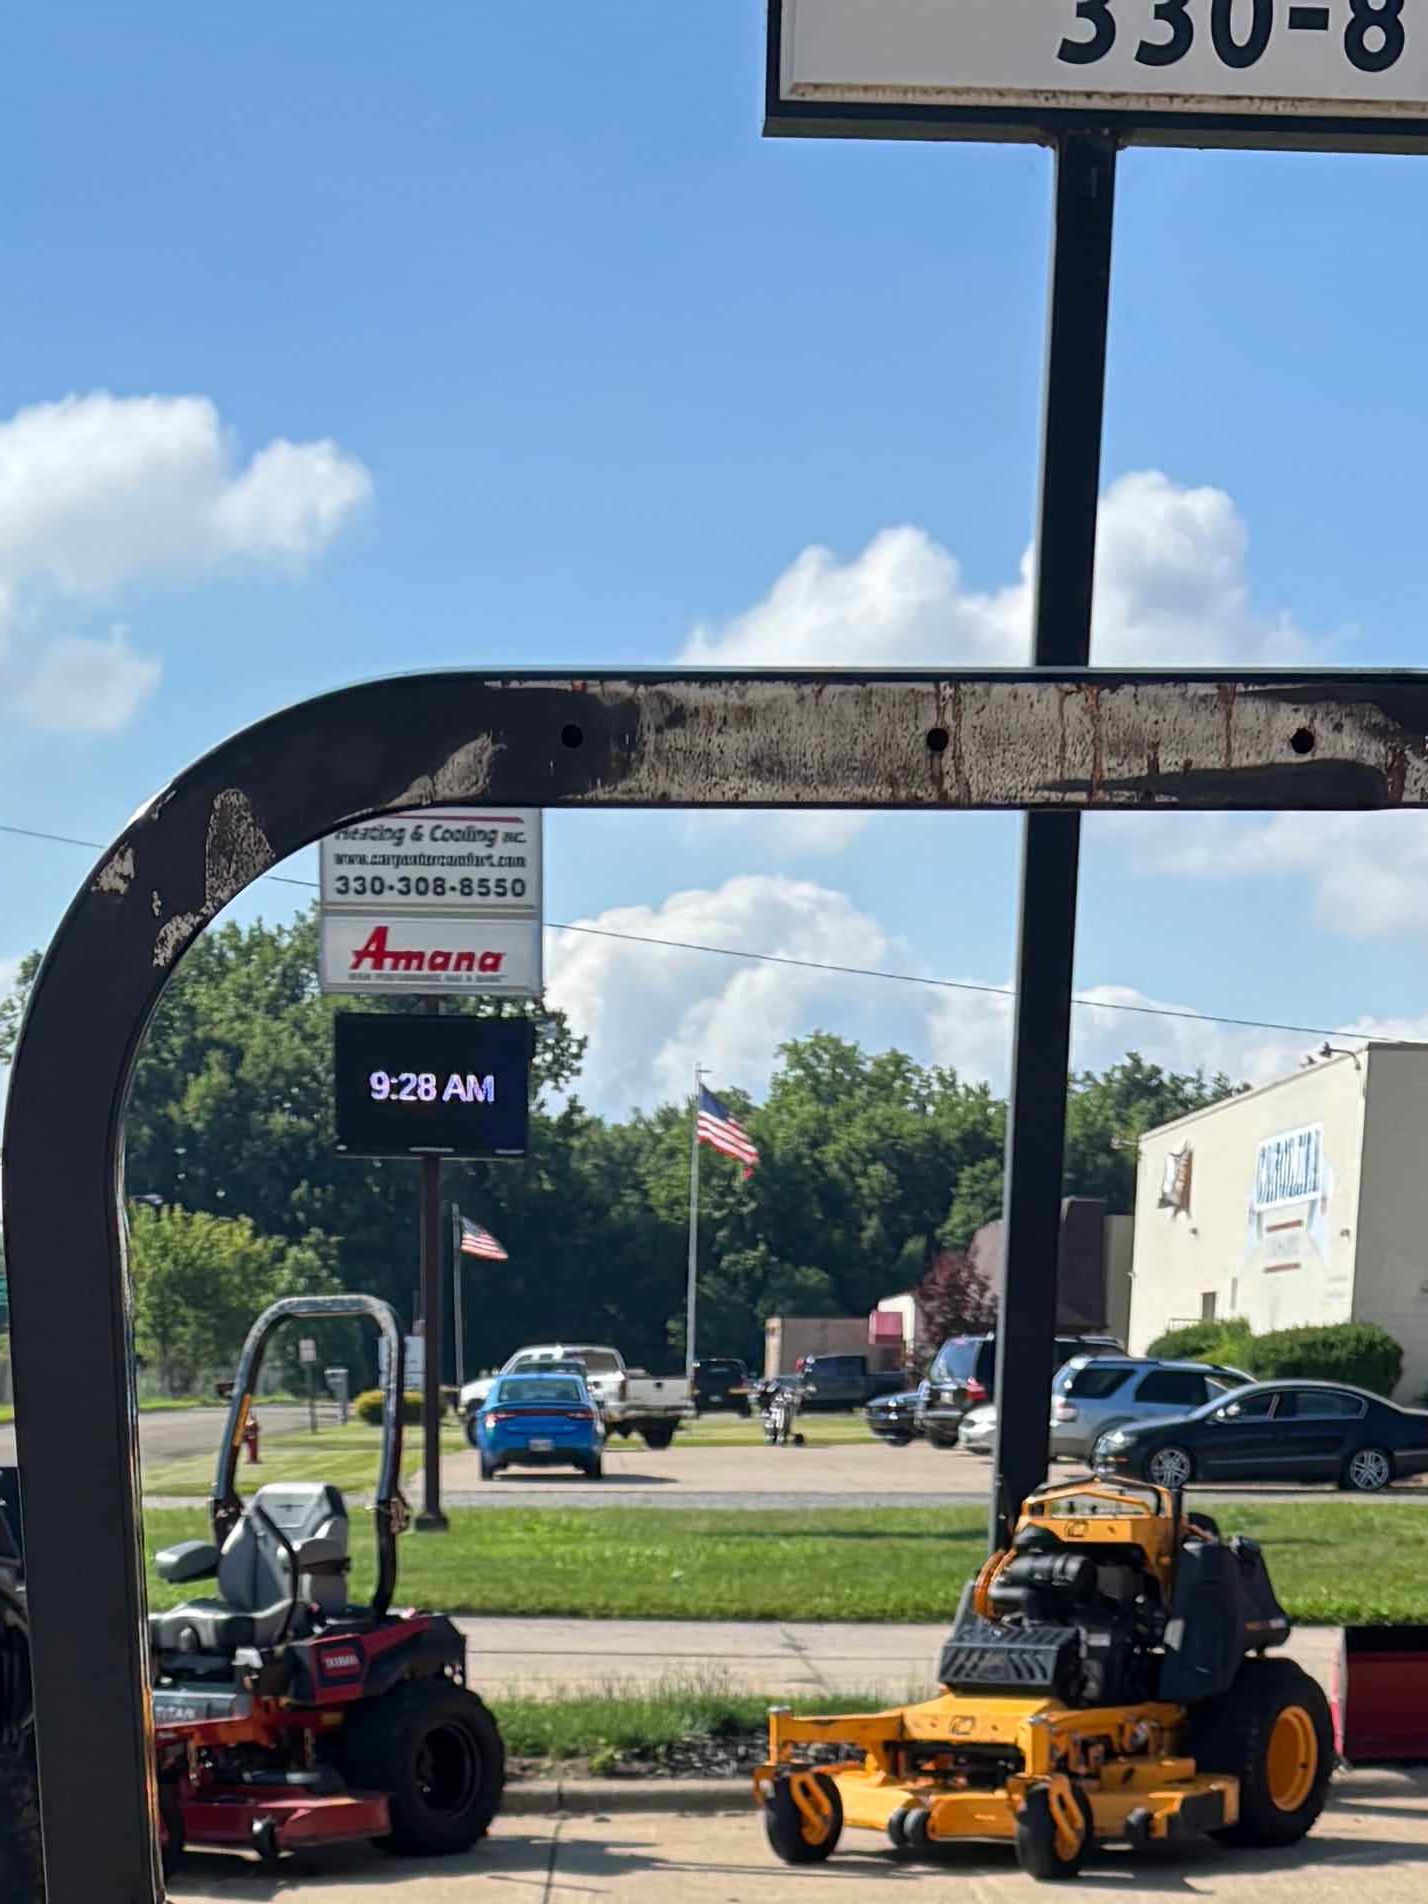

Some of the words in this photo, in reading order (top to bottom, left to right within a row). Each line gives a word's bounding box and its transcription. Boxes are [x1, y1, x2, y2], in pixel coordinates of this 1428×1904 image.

[410, 825, 424, 841] &
[429, 825, 498, 847] Cooling
[349, 926, 506, 972] Amana
[369, 1071, 437, 1101] 9:28
[442, 1073, 495, 1102] AM
